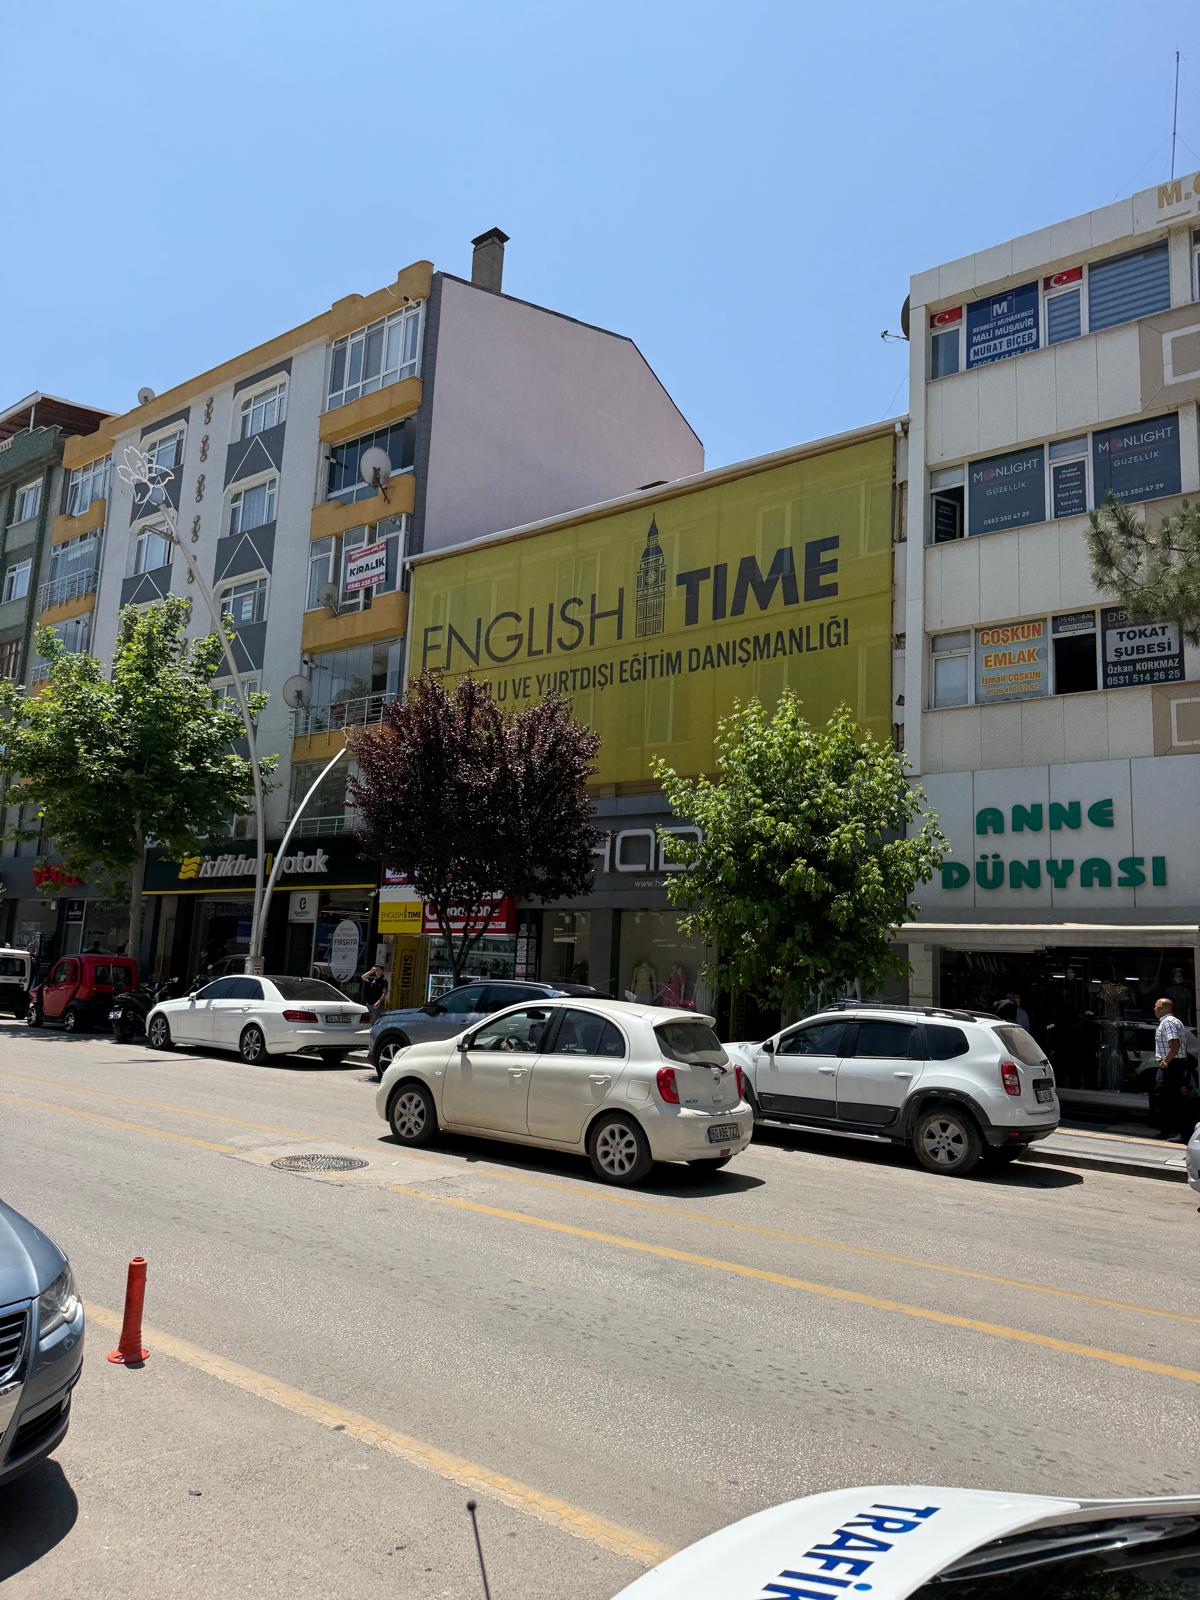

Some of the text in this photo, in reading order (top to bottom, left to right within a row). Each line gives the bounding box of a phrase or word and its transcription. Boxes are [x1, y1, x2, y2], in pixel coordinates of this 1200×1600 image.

[973, 341, 1004, 359] MURAT
[1130, 487, 1144, 495] 350
[1155, 482, 1164, 490] 29
[421, 535, 840, 673] ENGLISH TIME
[980, 623, 1042, 646] COŞKUN
[1116, 625, 1169, 642] TOKAT
[512, 676, 531, 699] VE
[535, 663, 614, 697] YURTDIŞI
[619, 649, 682, 684] EĞİTİM
[688, 615, 850, 673] DANIŞMANLIĞI
[984, 647, 1039, 669] EMLAK
[1113, 637, 1172, 660] ŞUBESİ
[1107, 658, 1179, 675] Özkan KORKMAZ
[1107, 675, 1129, 686] 0531
[1132, 673, 1151, 683] 514
[1168, 669, 1181, 679] 25
[976, 798, 1114, 836] ANNE
[199, 853, 258, 878] istikba
[941, 853, 1167, 889] DÜNYASI
[407, 911, 422, 919] TIME
